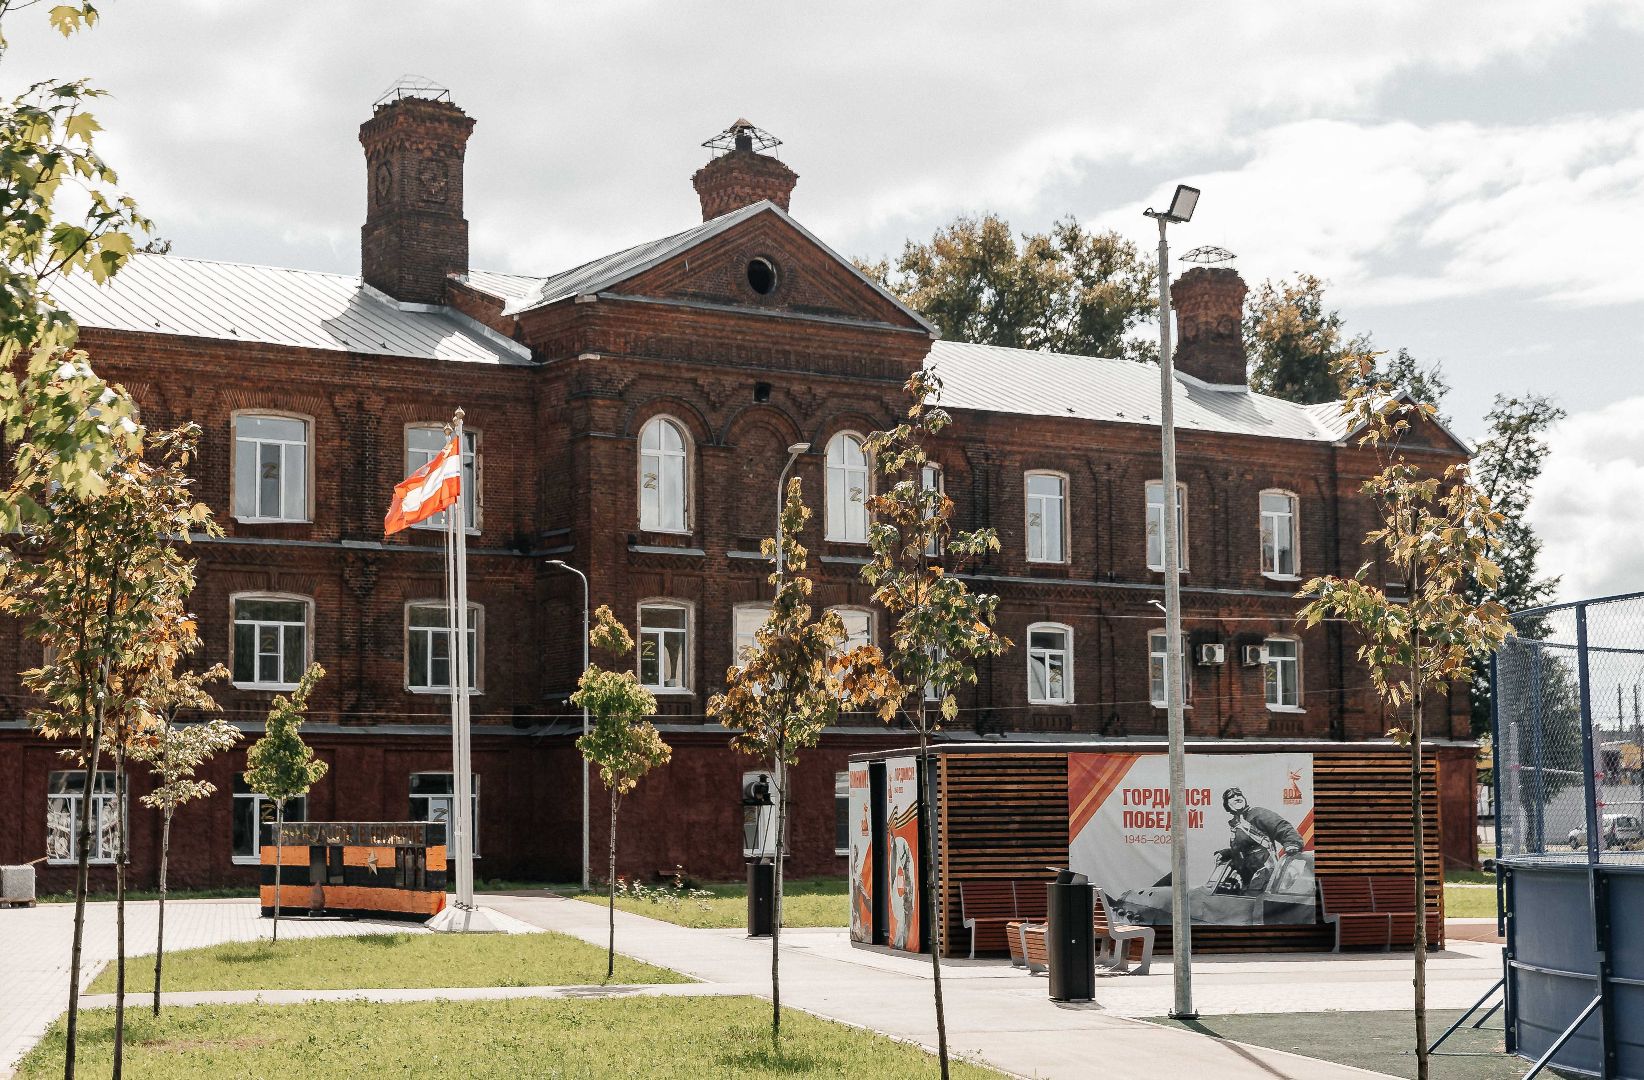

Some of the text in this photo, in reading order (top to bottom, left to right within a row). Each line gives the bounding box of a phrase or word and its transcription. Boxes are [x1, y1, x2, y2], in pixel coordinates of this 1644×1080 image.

[262, 462, 279, 479] Z
[643, 472, 656, 489] Z
[849, 487, 862, 502] Z
[1029, 512, 1041, 527] Z
[642, 641, 656, 656] Z
[1122, 788, 1211, 808] ГОРДИСЯ
[261, 803, 276, 820] Z
[433, 807, 448, 822] Z
[1123, 809, 1204, 831] ПОБЕЙ!
[1124, 834, 1171, 844] 1945–202
